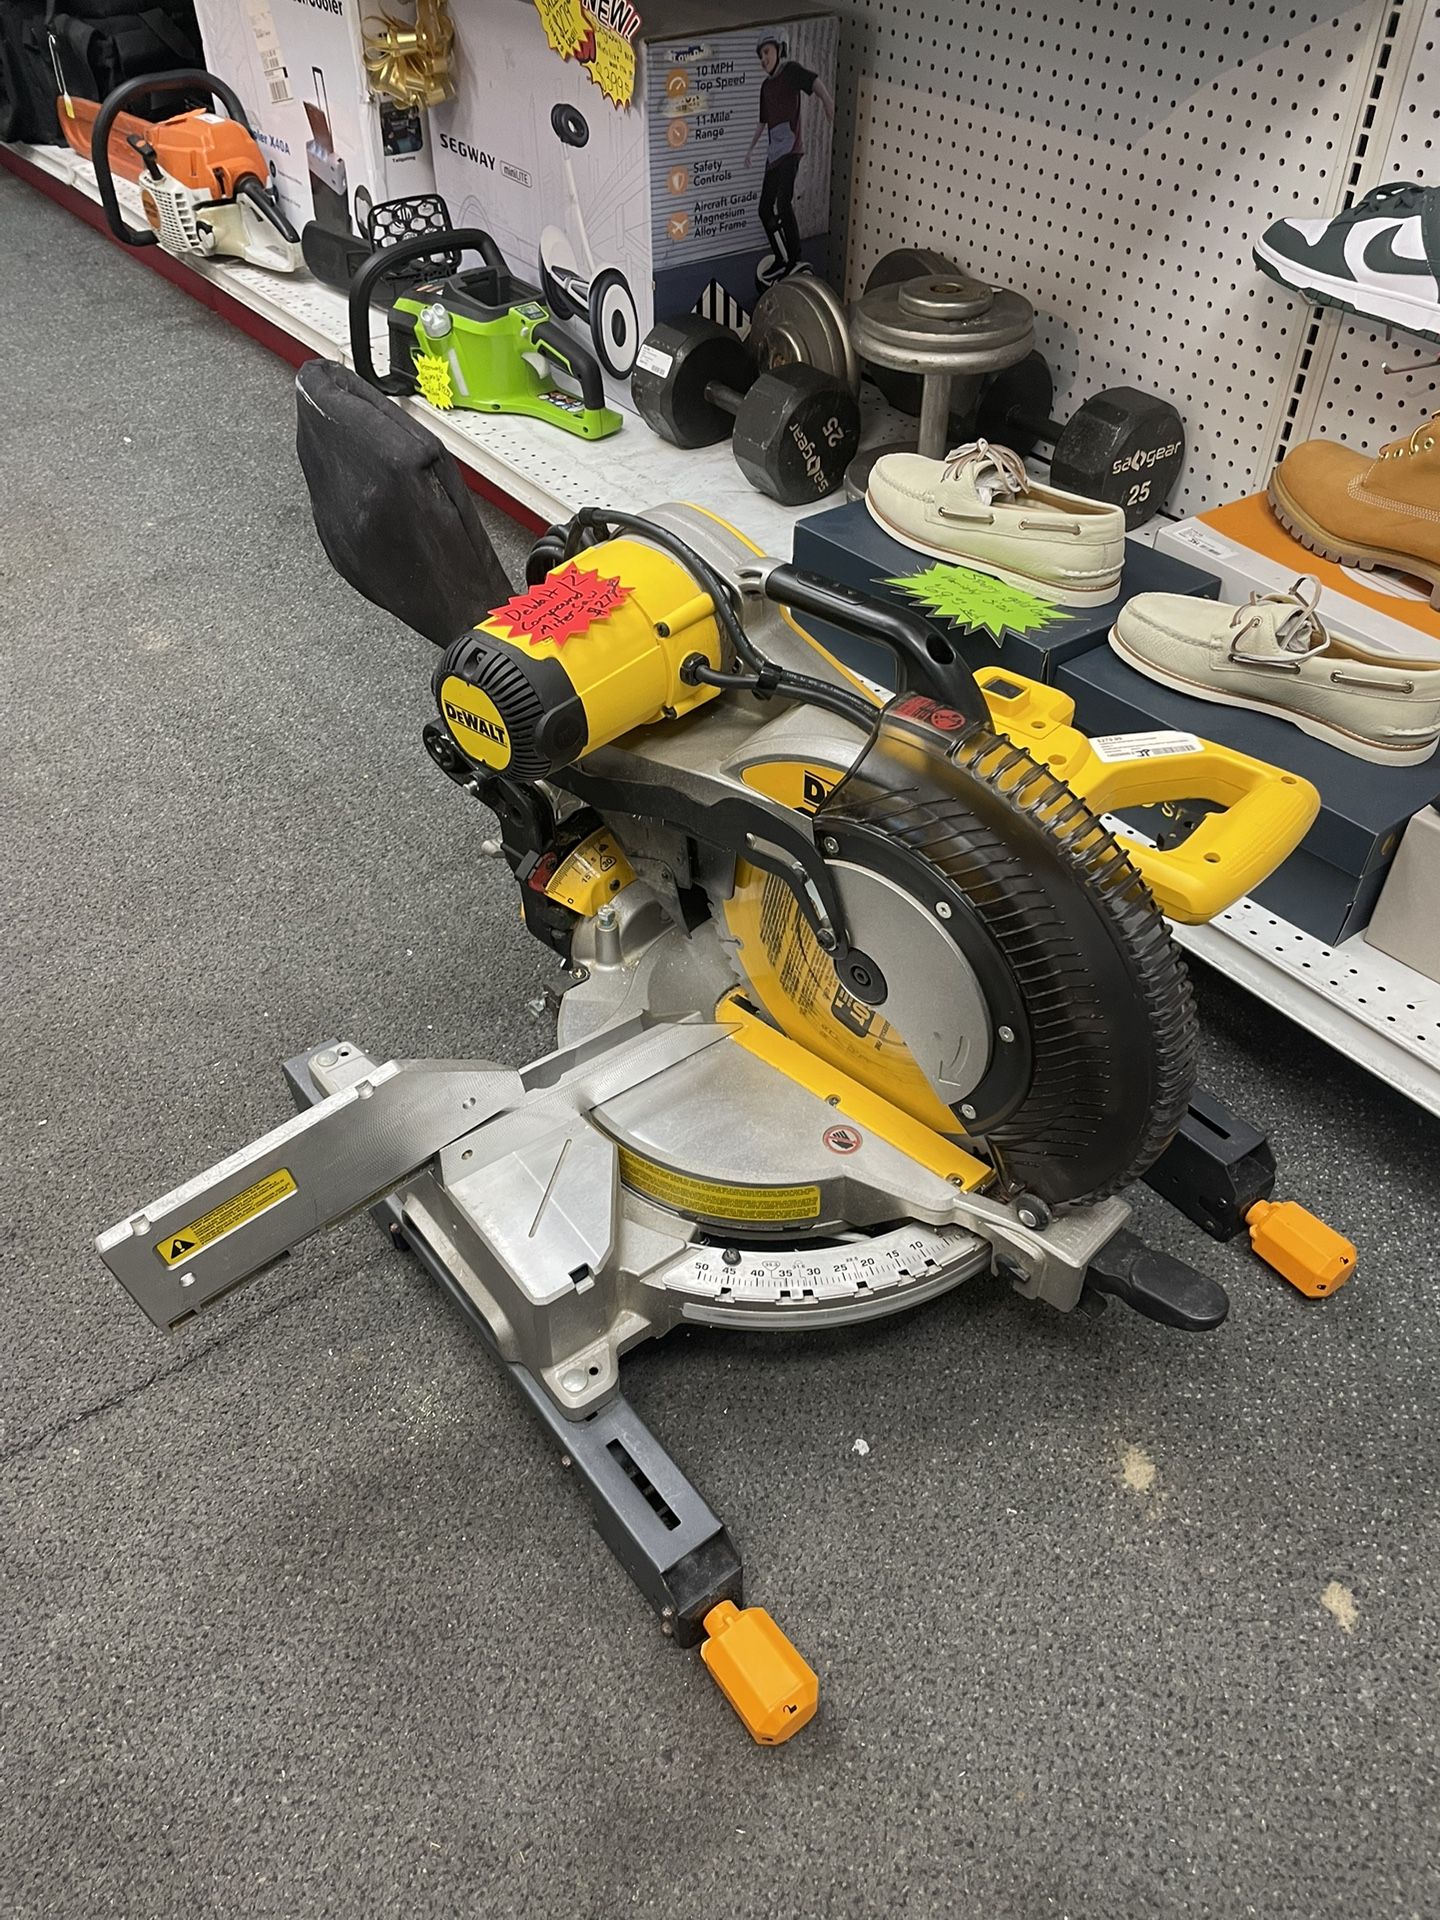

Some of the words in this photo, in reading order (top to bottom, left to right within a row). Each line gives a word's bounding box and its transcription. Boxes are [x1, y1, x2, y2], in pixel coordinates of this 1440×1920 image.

[696, 65, 708, 77] 10
[711, 61, 734, 75] MPH
[696, 80, 713, 92] Top
[716, 72, 746, 90] Speed
[695, 128, 725, 140] Range
[440, 133, 496, 171] SEGWAY
[693, 160, 723, 174] Safety
[693, 170, 732, 187] Controls
[694, 197, 728, 213] Aircraft
[730, 191, 758, 206] Grade
[694, 208, 746, 226] Magnesium
[694, 227, 717, 238] Alloy
[719, 221, 747, 233] Frame
[822, 417, 844, 447] 25
[1127, 480, 1152, 506] 25
[521, 592, 583, 631] Compound
[694, 1261, 709, 1271] 50
[722, 1266, 736, 1275] 45
[750, 1269, 765, 1277] 40
[778, 1269, 793, 1277] 35
[807, 1267, 821, 1276] 30
[833, 1263, 848, 1272] 25
[860, 1257, 875, 1267] 20
[886, 1250, 900, 1259] 15
[909, 1241, 923, 1250] 10
